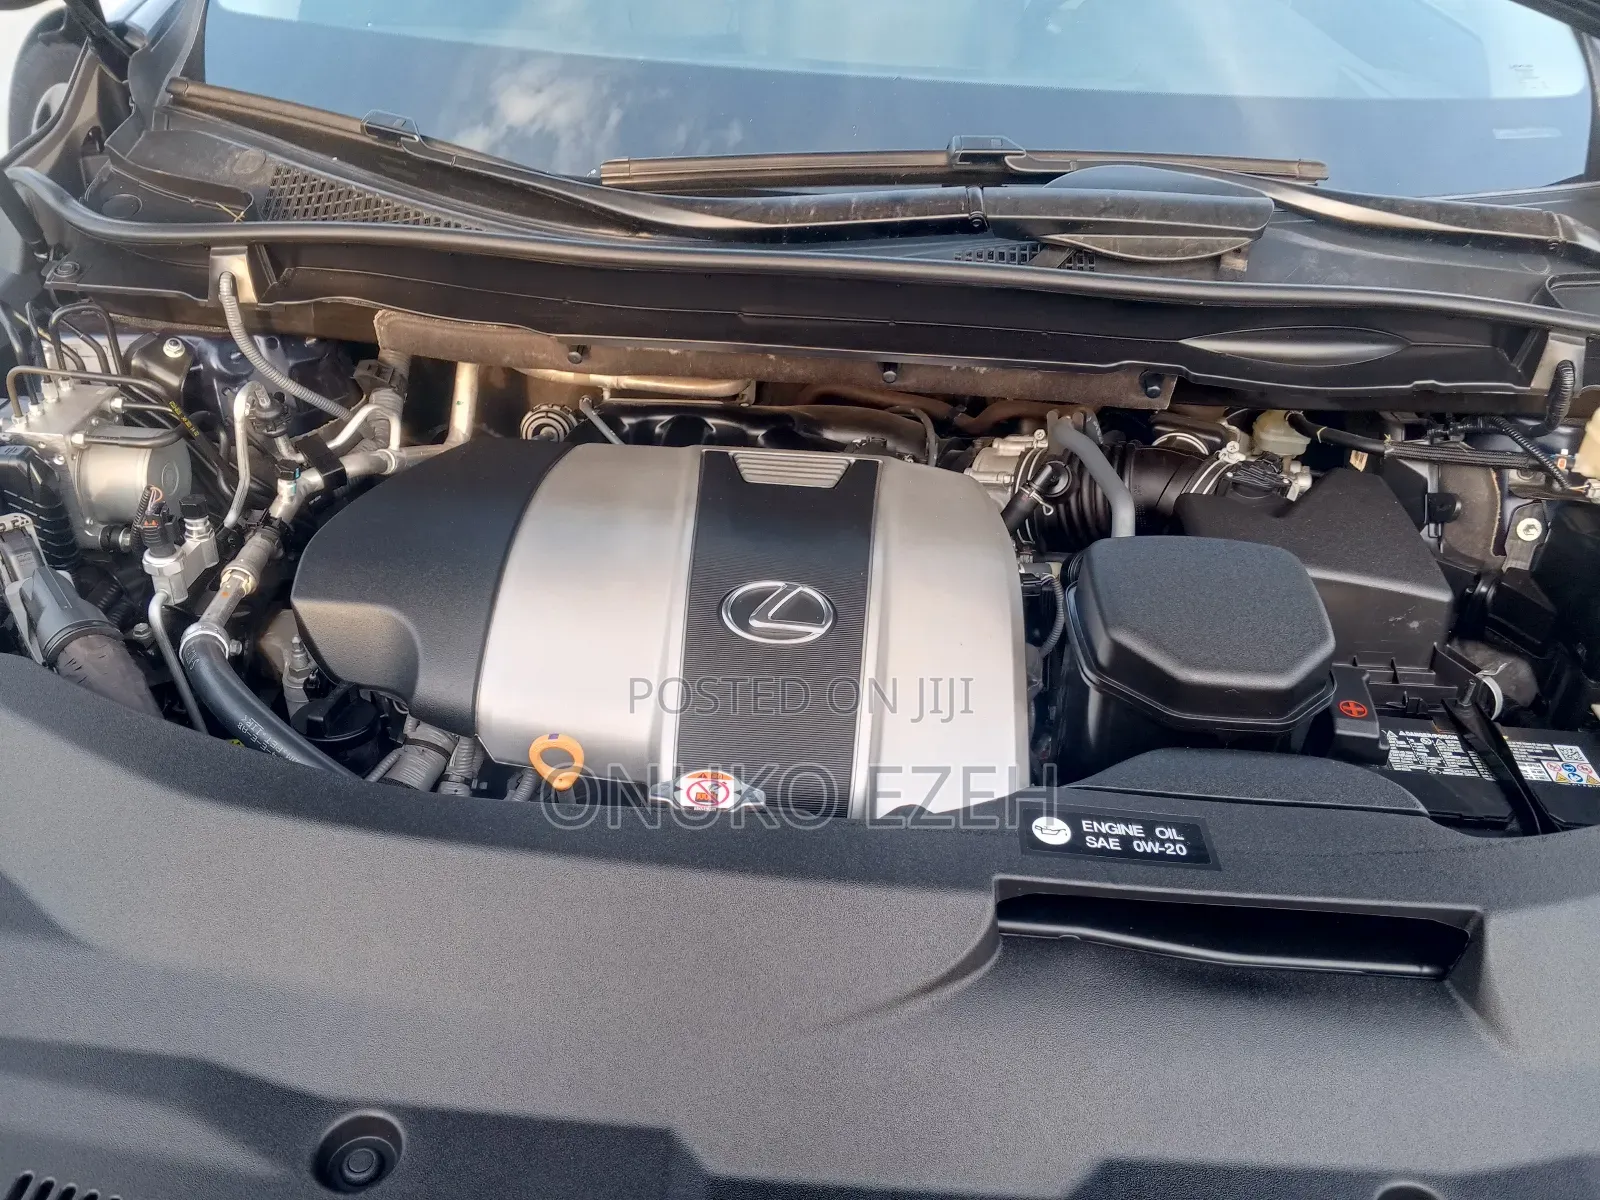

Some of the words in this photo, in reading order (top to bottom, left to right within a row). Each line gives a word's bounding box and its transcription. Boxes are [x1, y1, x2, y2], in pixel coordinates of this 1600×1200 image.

[1081, 820, 1145, 837] ENGINE
[1155, 827, 1184, 840] OIL
[1086, 835, 1121, 850] SAE
[1133, 842, 1187, 856] 0W-20
